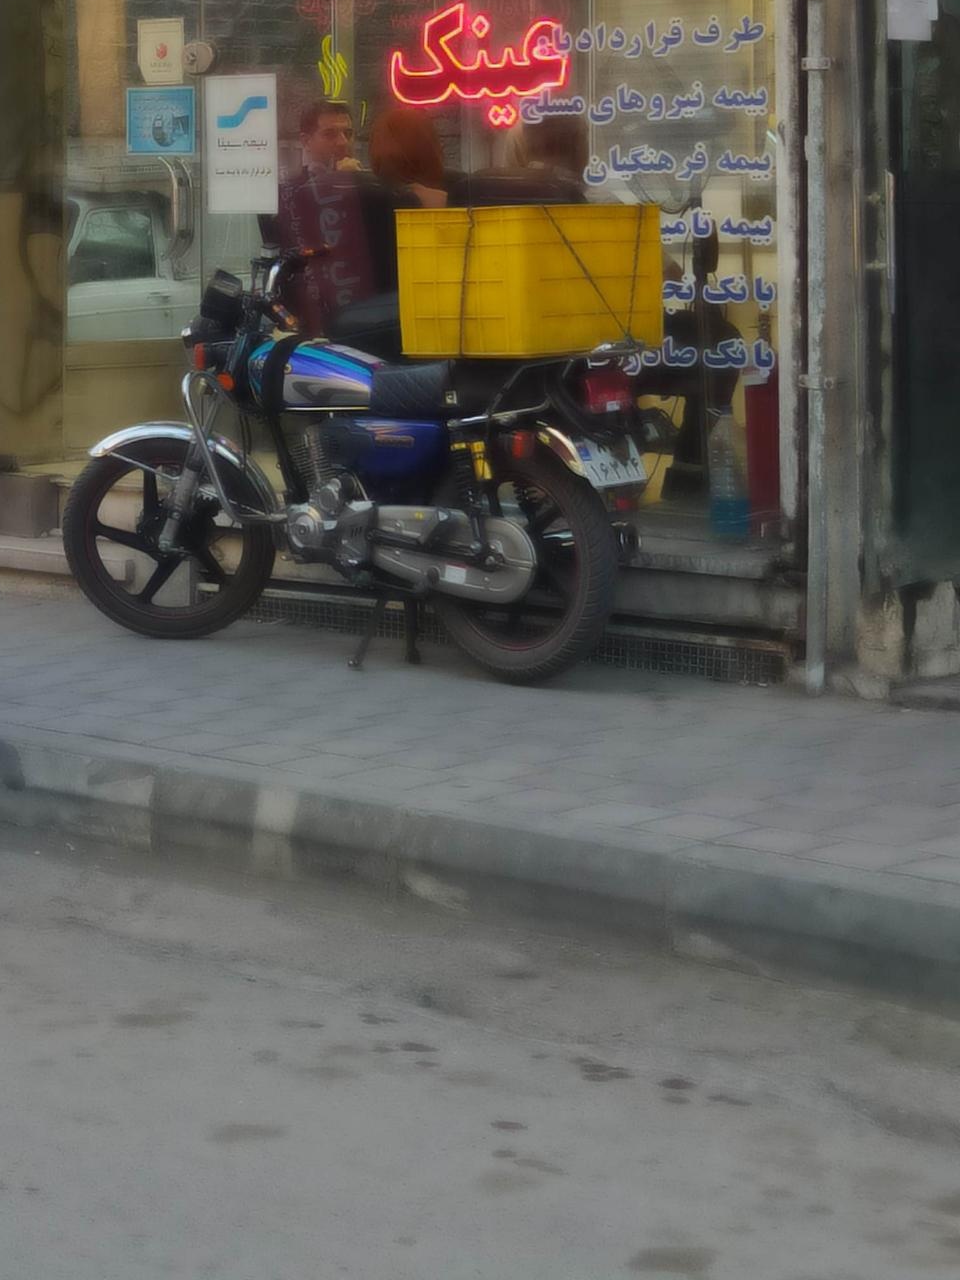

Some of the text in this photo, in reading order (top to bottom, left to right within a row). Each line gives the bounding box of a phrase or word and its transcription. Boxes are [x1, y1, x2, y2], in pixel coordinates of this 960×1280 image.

[694, 16, 764, 53] طرف
[390, 2, 567, 128] عینک
[521, 86, 586, 125] مسلح
[713, 86, 768, 115] بیمه
[583, 141, 773, 187] بیمه فرهنگیان
[660, 206, 773, 245] بیمه تامی
